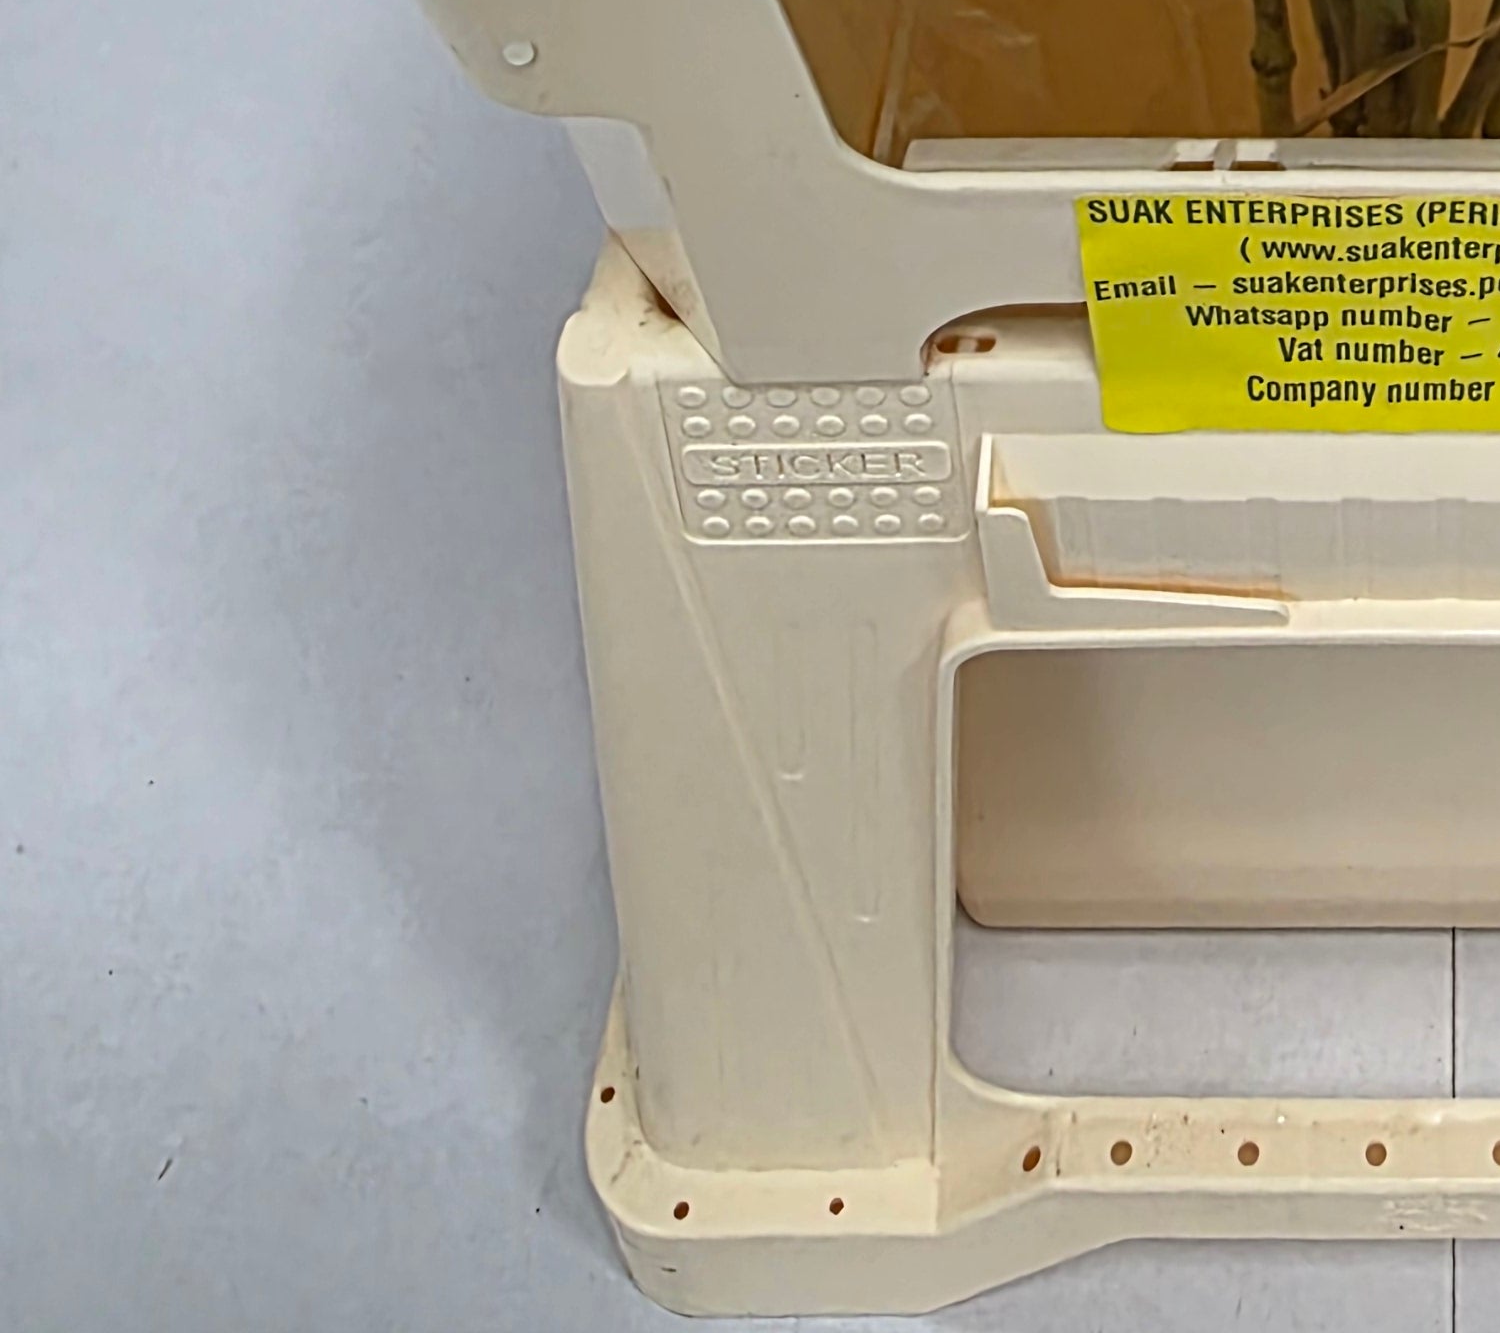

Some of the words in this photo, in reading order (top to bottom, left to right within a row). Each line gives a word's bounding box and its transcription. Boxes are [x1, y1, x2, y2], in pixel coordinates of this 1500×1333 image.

[1088, 199, 1173, 225] SUAK
[1187, 200, 1403, 229] ENTERPRISES
[1094, 275, 1176, 301] Email
[1185, 305, 1329, 331] Whatsapp
[1341, 306, 1453, 333] number
[1278, 337, 1323, 362] Vat
[1336, 340, 1445, 366] number
[1247, 375, 1376, 408] Company
[1387, 378, 1495, 404] number
[710, 452, 926, 480] STICKER
